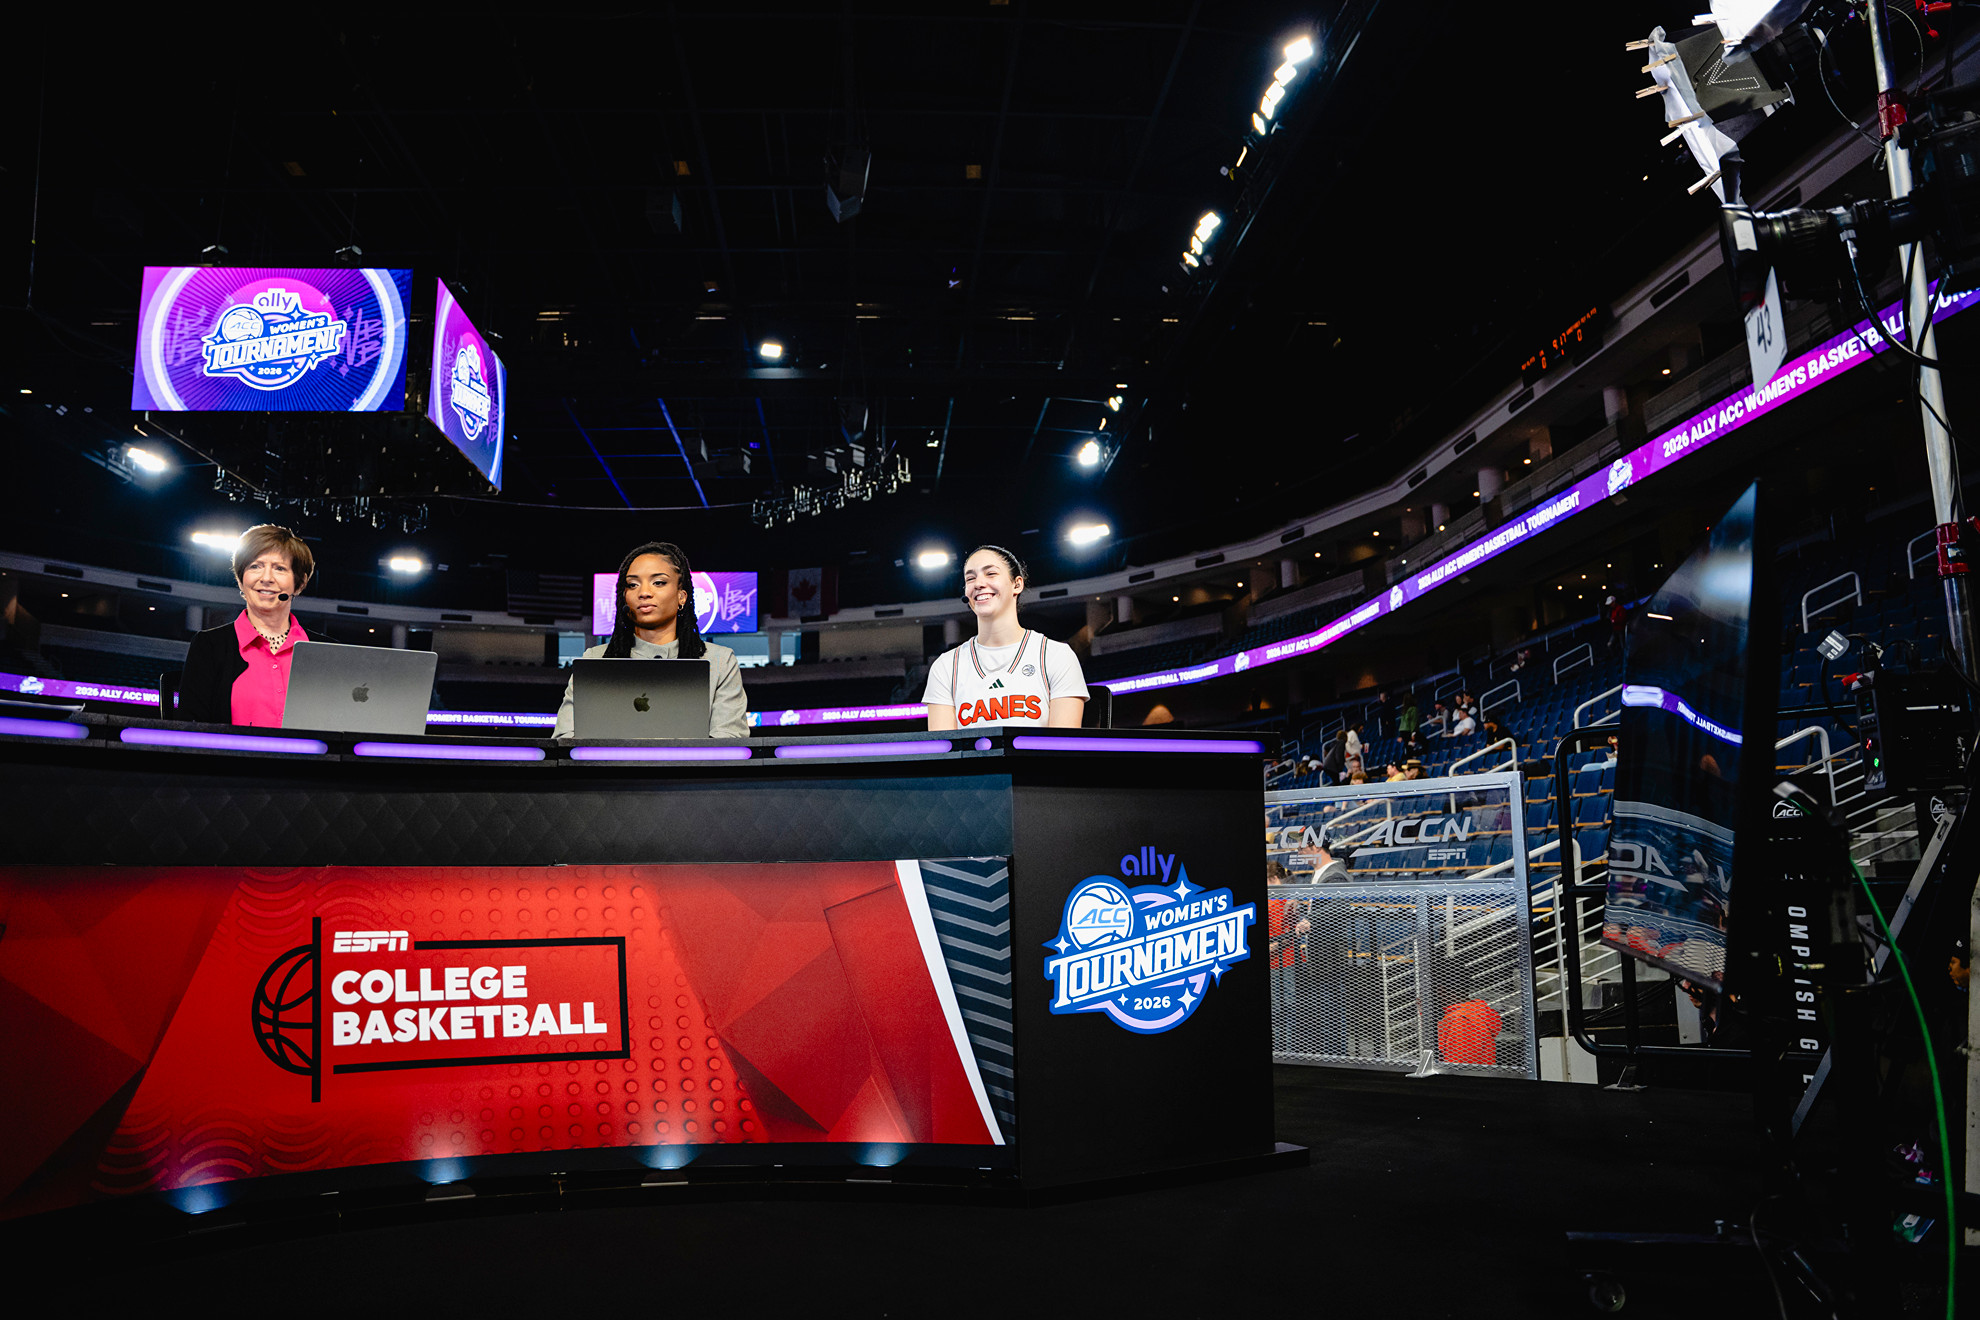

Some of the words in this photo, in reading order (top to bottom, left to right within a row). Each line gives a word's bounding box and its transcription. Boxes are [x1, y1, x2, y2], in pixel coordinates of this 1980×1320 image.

[258, 293, 292, 310] ally
[229, 321, 260, 330] ACC
[269, 317, 326, 335] WOMEN'S
[208, 324, 343, 371] TOURNAMENT
[257, 367, 282, 375] 2026
[1662, 431, 1690, 458] 2026
[1691, 415, 1716, 444] ALLY
[1719, 401, 1744, 428] ACC
[1744, 366, 1807, 413] WOMEN'S
[1456, 544, 1484, 569] WOMEN'S
[1484, 521, 1527, 554] BASKETBALL
[1526, 490, 1580, 531] TOURNAMENT
[1296, 639, 1309, 651] ACC
[1135, 673, 1179, 689] BASKETBALL
[1178, 664, 1219, 681] TOURNAMENT
[75, 686, 99, 696] 2026
[99, 688, 122, 699] ALLY
[123, 691, 142, 701] ACC
[463, 715, 513, 724] BASKETBALL
[841, 710, 859, 719] ALLY
[860, 709, 875, 718] ACC
[876, 708, 910, 718] WOMEN'S
[958, 695, 1042, 727] CANES
[1363, 816, 1471, 846] ACCN
[1120, 846, 1175, 883] ally
[1428, 848, 1466, 861] ESPN
[1077, 907, 1130, 925] ACC
[1144, 894, 1228, 931] WOMEN'S
[333, 930, 409, 953] ESPN
[1049, 907, 1253, 1008] TOURNAMENT
[331, 965, 528, 1005] COLLEGE
[1133, 996, 1171, 1010] 2026
[333, 1001, 607, 1046] BASKETBALL
